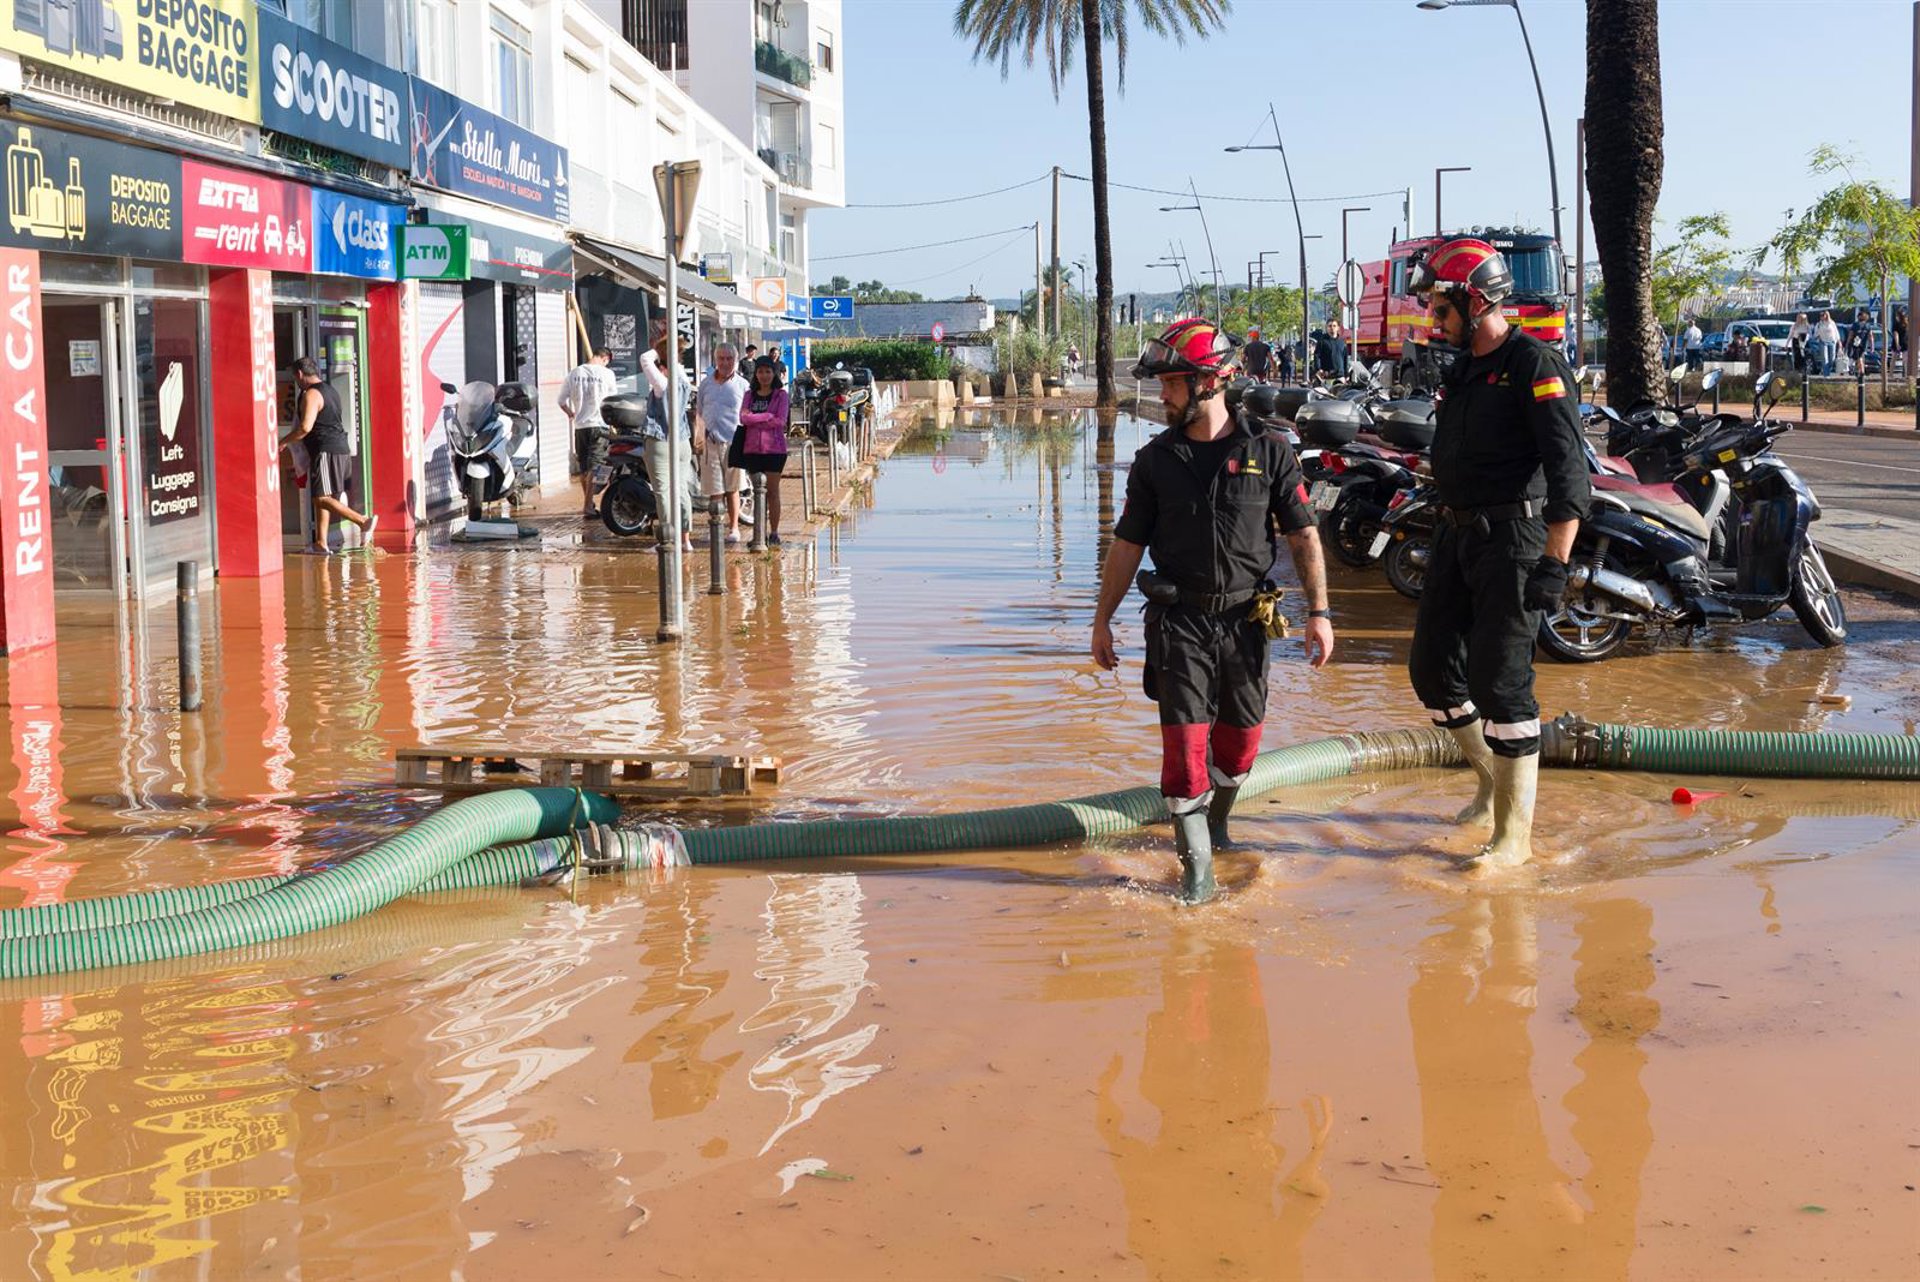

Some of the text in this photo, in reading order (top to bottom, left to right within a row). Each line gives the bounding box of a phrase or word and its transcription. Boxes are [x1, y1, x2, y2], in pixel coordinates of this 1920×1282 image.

[137, 0, 248, 57] DEPOSITO
[137, 22, 249, 99] BAGGAGE
[272, 43, 401, 146] SCOOTER
[461, 119, 504, 172] Stella
[504, 140, 542, 187] Maris
[111, 174, 171, 206] DEPOSITO
[111, 201, 171, 231] BAGGAGE
[216, 222, 261, 252] rent
[347, 208, 388, 251] Class
[406, 245, 448, 260] ATM
[252, 276, 266, 402] RENT
[677, 304, 696, 350] CAR
[262, 278, 280, 492] SCOOTER
[5, 264, 43, 577] RENT A CAR
[161, 444, 184, 461] Left
[151, 471, 195, 491] Luggage
[151, 495, 198, 516] Consigna
